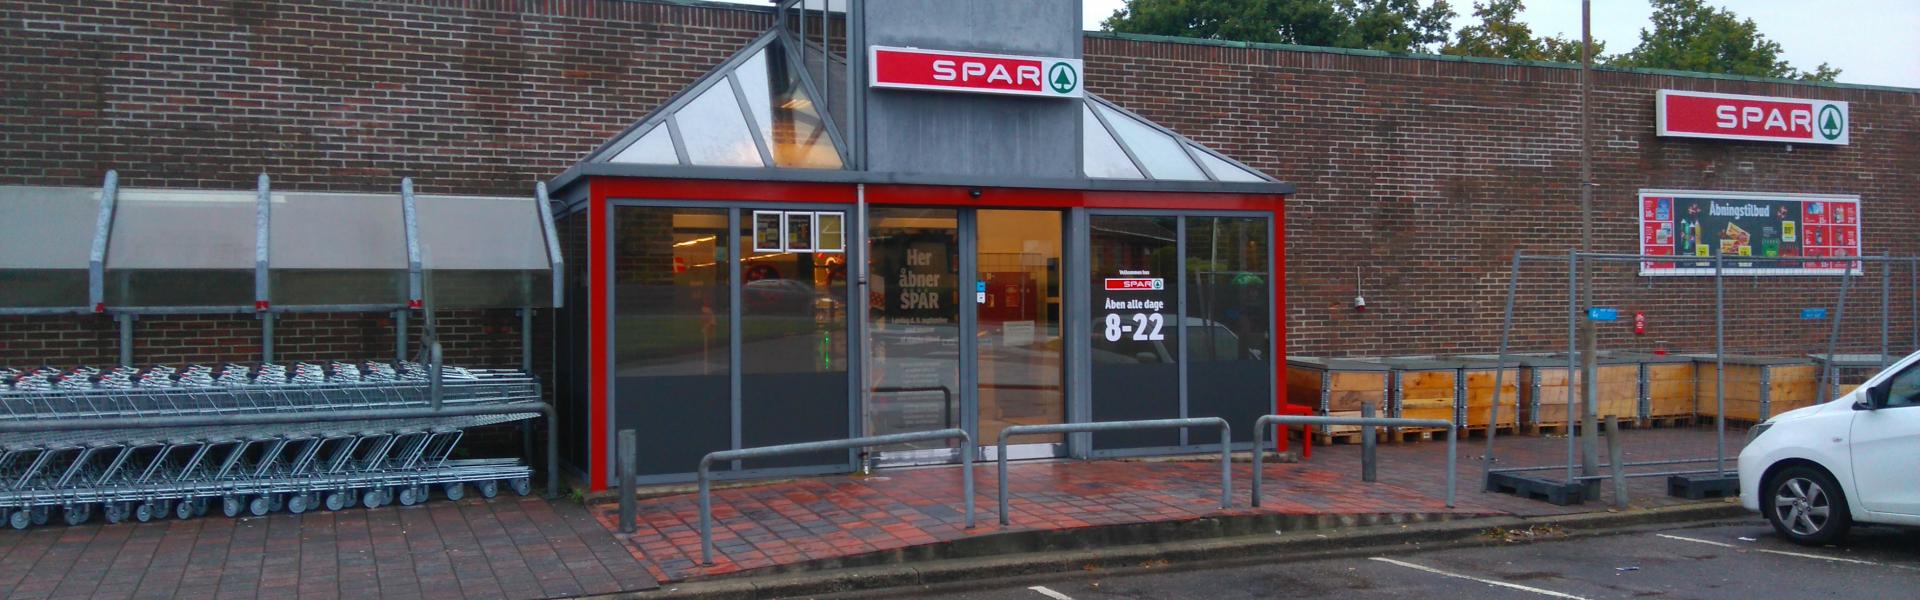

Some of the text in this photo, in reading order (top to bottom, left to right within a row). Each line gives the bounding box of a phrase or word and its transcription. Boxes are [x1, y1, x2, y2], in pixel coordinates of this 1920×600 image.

[932, 60, 1041, 86] SPAR
[1716, 105, 1811, 132] SPAR
[1709, 201, 1770, 220] Åbningstilbud
[906, 249, 932, 266] Her
[899, 268, 940, 287] åbner
[1123, 280, 1152, 288] SPAR
[900, 292, 940, 309] SPAR
[1105, 298, 1164, 311] Åben alle dage
[1105, 313, 1164, 341] 8-22
